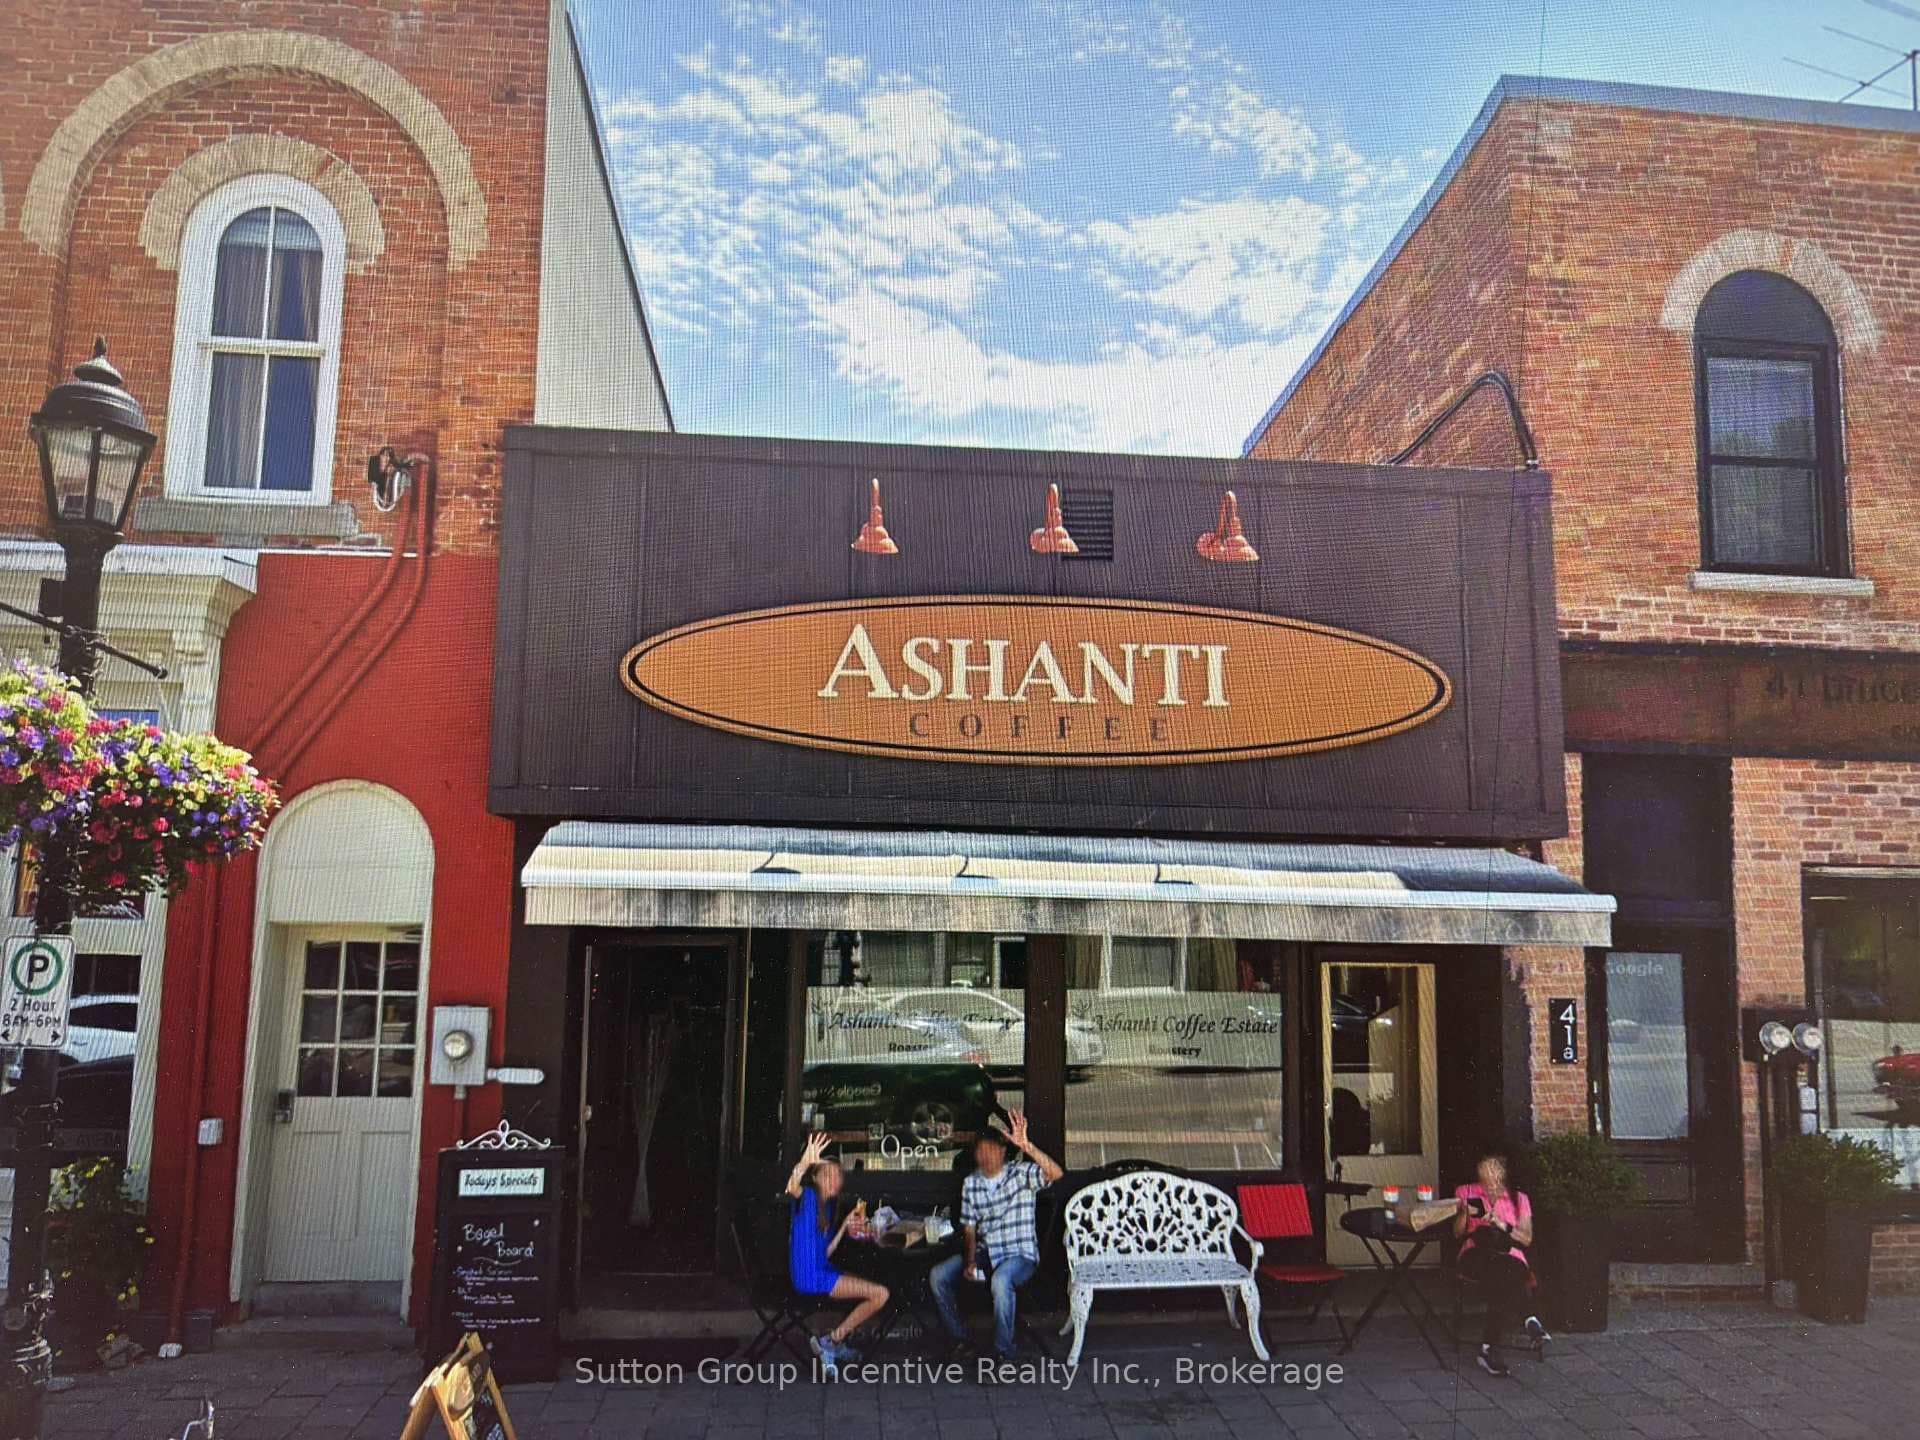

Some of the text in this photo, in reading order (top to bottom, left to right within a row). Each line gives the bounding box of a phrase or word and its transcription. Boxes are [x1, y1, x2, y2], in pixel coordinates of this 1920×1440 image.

[817, 623, 1229, 706] ASHANTI
[909, 712, 1168, 741] COFFEE
[27, 954, 50, 984] P
[10, 998, 18, 1012] 2
[1162, 1012, 1217, 1040] Coffee
[1221, 1016, 1279, 1035] Estate
[881, 1133, 939, 1171] Open
[462, 1222, 504, 1247] Bagel
[495, 1240, 534, 1257] Board
